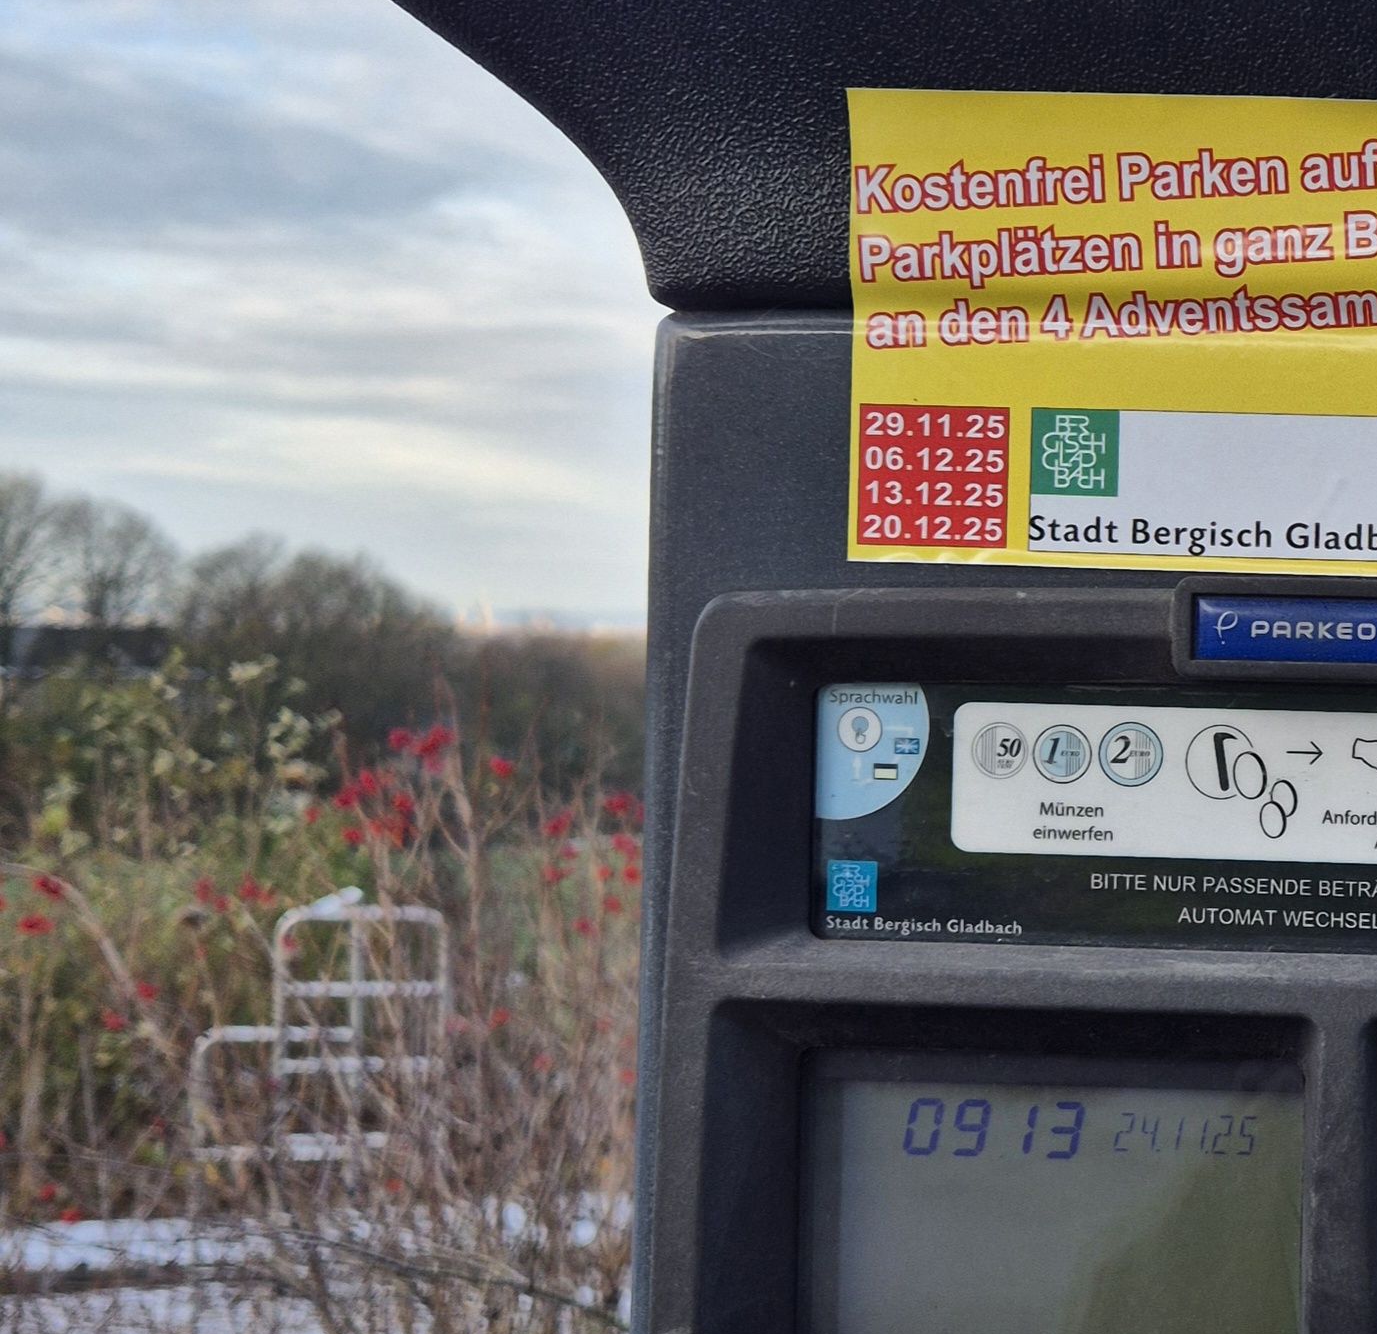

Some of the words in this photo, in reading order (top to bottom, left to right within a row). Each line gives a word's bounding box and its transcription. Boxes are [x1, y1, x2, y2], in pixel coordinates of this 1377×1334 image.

[856, 154, 1105, 214] Kostenfrei
[1117, 148, 1289, 202] Parken
[857, 224, 1143, 289] Parkplätzen
[1154, 220, 1201, 268] in
[1214, 222, 1334, 277] ganz
[866, 310, 927, 349] an
[939, 298, 1030, 346] den
[1040, 294, 1074, 342] 4
[864, 411, 1006, 440] 29.11.25
[864, 445, 1005, 474] 06.12.25
[864, 480, 1004, 508] 13.12.25
[862, 514, 1003, 543] 20.12.25
[1028, 514, 1120, 545] Stadt
[1130, 518, 1272, 556] Bergisch
[829, 689, 919, 706] Sprachwahl
[997, 738, 1022, 758] 50
[1041, 737, 1060, 765] 1
[1110, 735, 1131, 764] 2
[1039, 801, 1104, 818] Münzen
[1033, 826, 1114, 841] einwerfen
[1090, 873, 1147, 891] BITTE
[1153, 875, 1196, 893] NUR
[1203, 877, 1311, 897] PASSENDE
[826, 915, 869, 930] Stadt
[873, 917, 941, 936] Bergisch
[947, 919, 1023, 935] Gladbach
[1178, 907, 1278, 927] AUTOMAT
[1113, 1112, 1257, 1156] 24.11.25
